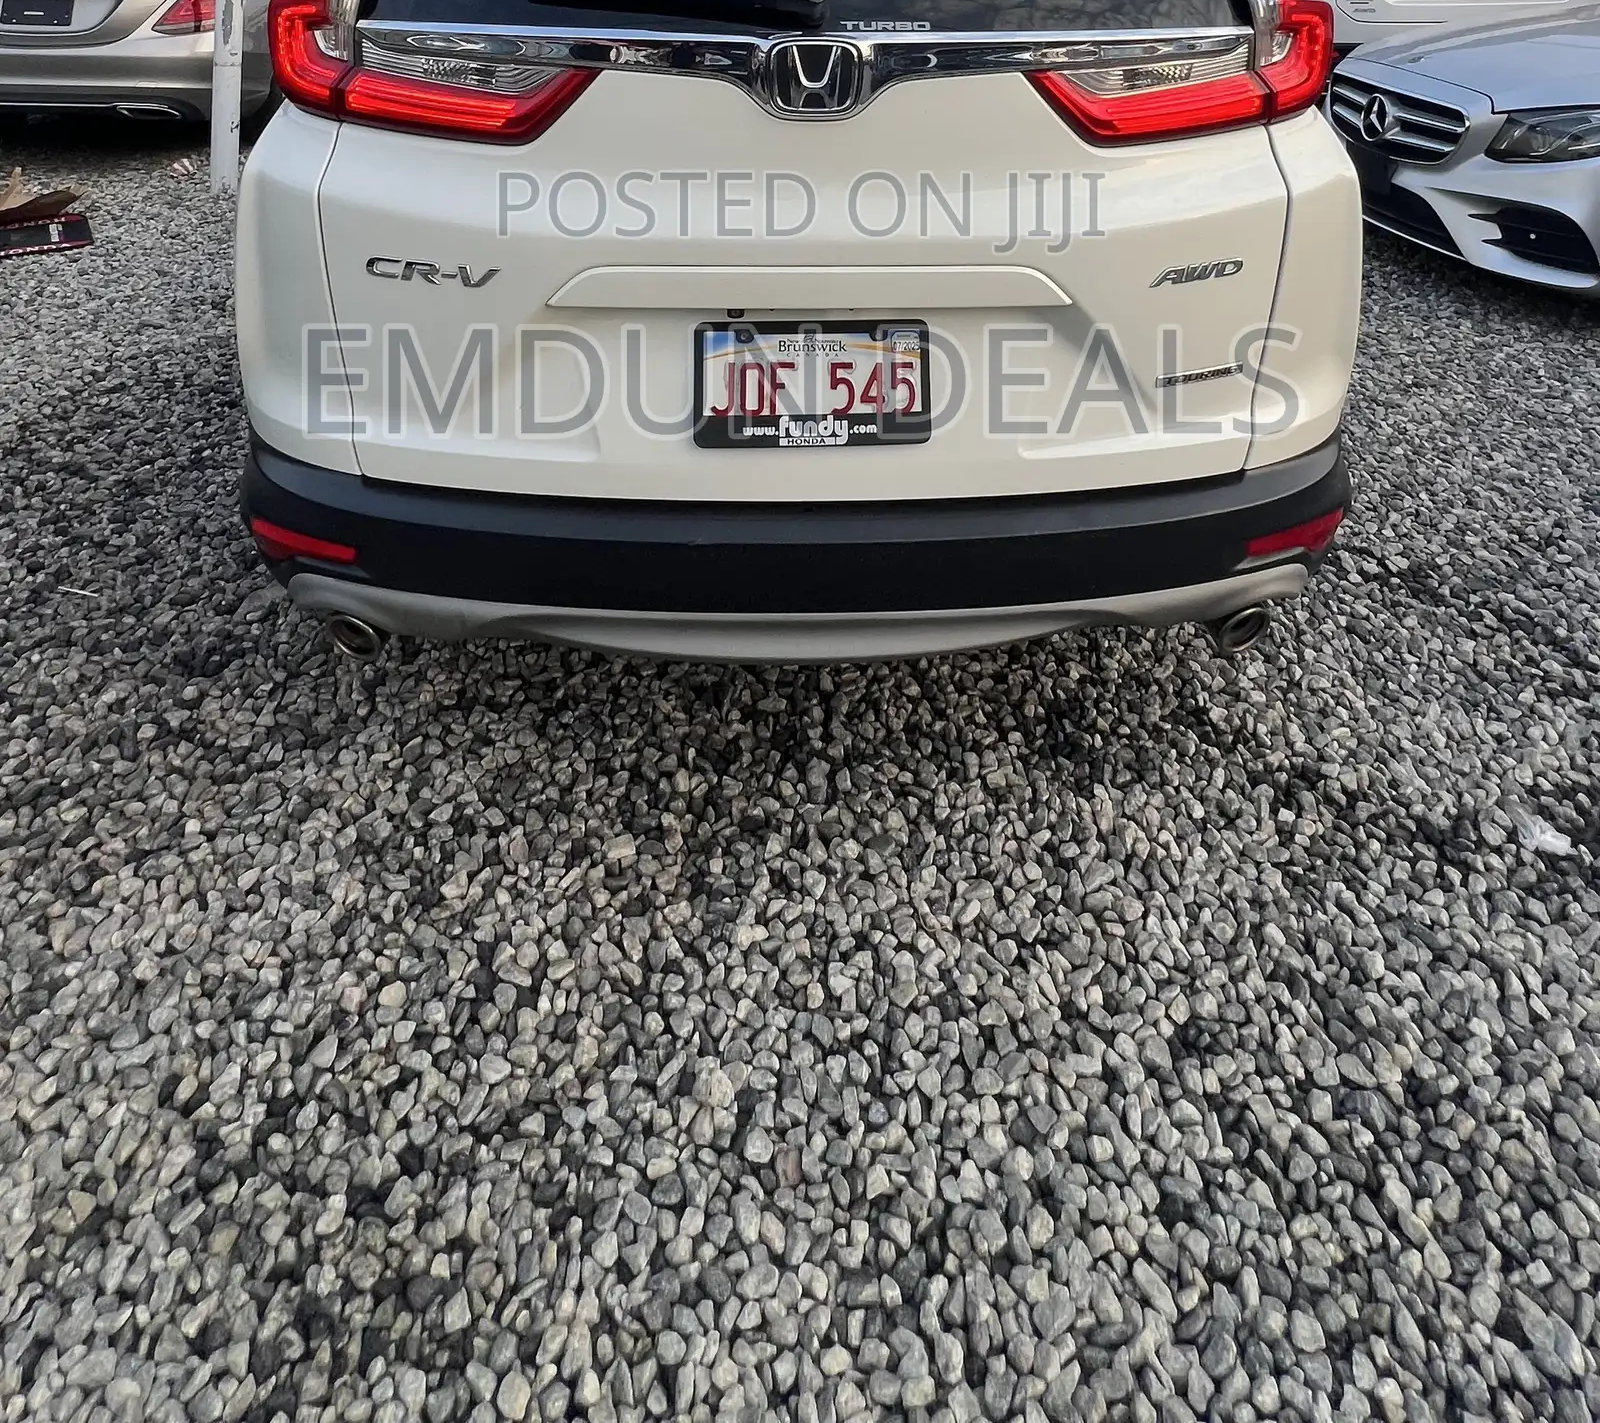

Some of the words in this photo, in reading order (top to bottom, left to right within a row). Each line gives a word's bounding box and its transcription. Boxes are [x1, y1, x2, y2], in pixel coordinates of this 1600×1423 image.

[840, 21, 931, 31] TURBO
[366, 256, 500, 288] CR-V
[1149, 258, 1243, 288] AWD
[778, 339, 847, 352] Brunswick
[1162, 364, 1242, 387] TOURING
[711, 362, 795, 416] JOF
[830, 362, 915, 415] 545
[743, 415, 877, 445] www.fundy.com
[788, 437, 826, 445] HONDA
